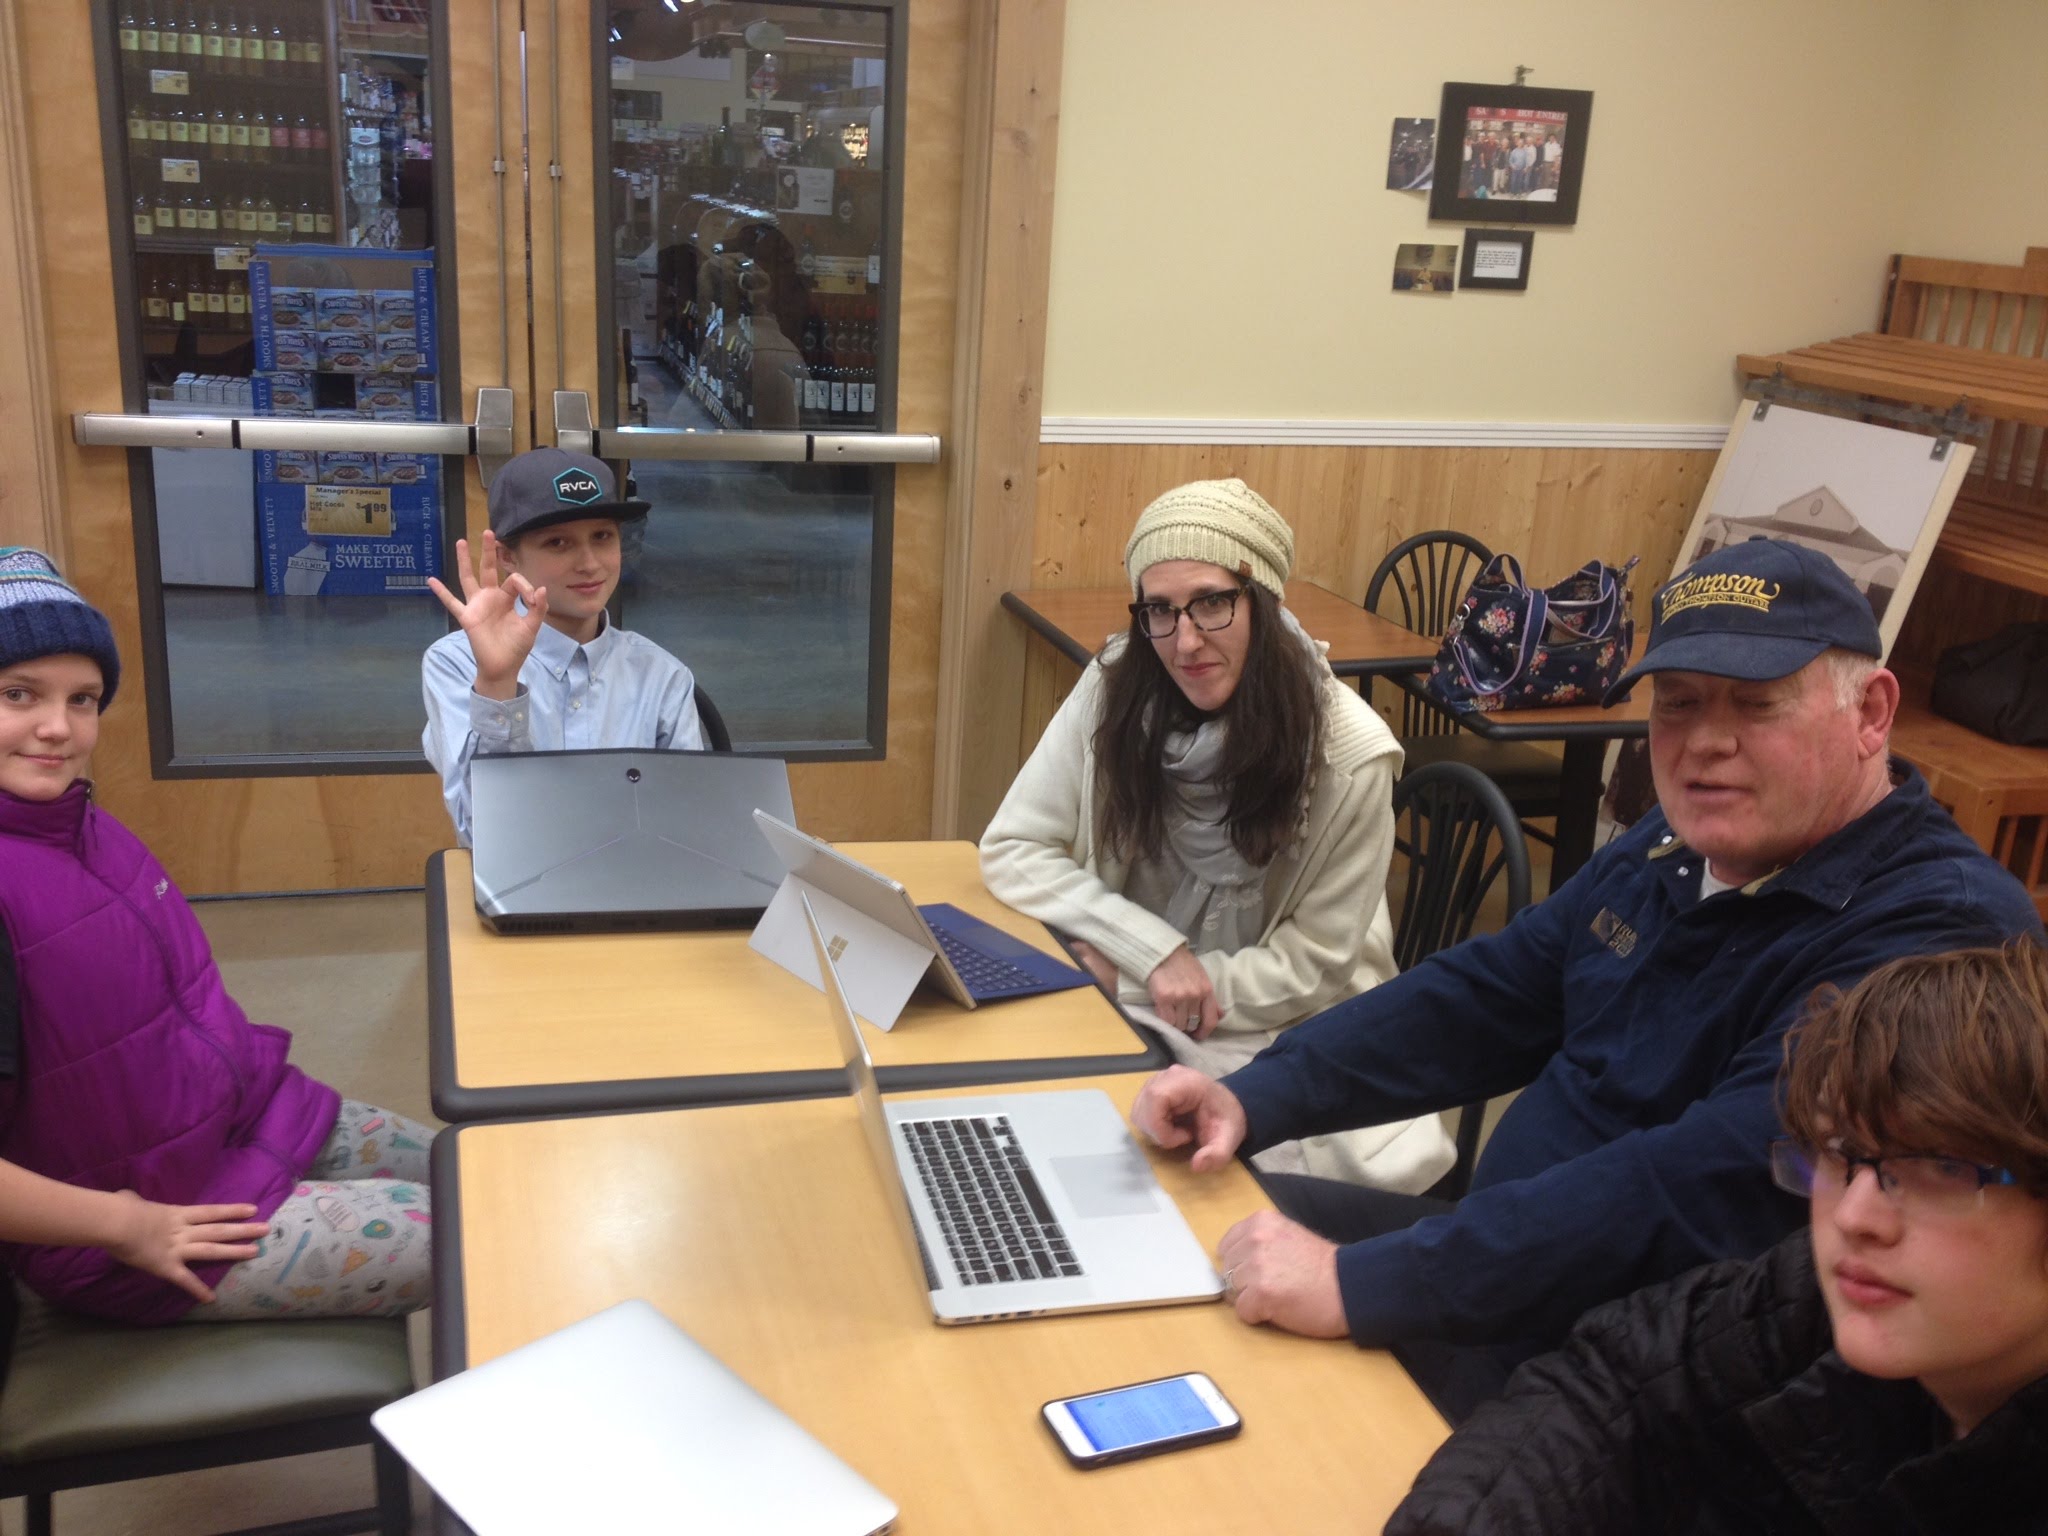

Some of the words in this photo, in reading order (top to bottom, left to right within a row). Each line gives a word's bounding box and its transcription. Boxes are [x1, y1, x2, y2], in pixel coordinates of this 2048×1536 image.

[255, 264, 267, 309] VELVETY
[417, 268, 427, 292] RICH
[420, 308, 430, 351] CREAMY
[260, 325, 272, 369] SMOOTH
[263, 452, 273, 481] SMOO
[316, 487, 354, 495] Manager's
[559, 481, 597, 494] RVCA
[264, 497, 275, 539] VELVETY
[421, 497, 431, 520] RICH
[335, 544, 370, 554] MAKE
[373, 544, 413, 554] TODAY
[335, 554, 416, 570] SWEETER
[424, 533, 434, 573] CREAMY
[268, 554, 279, 594] SMOOTH
[1661, 571, 1780, 610] Thompson
